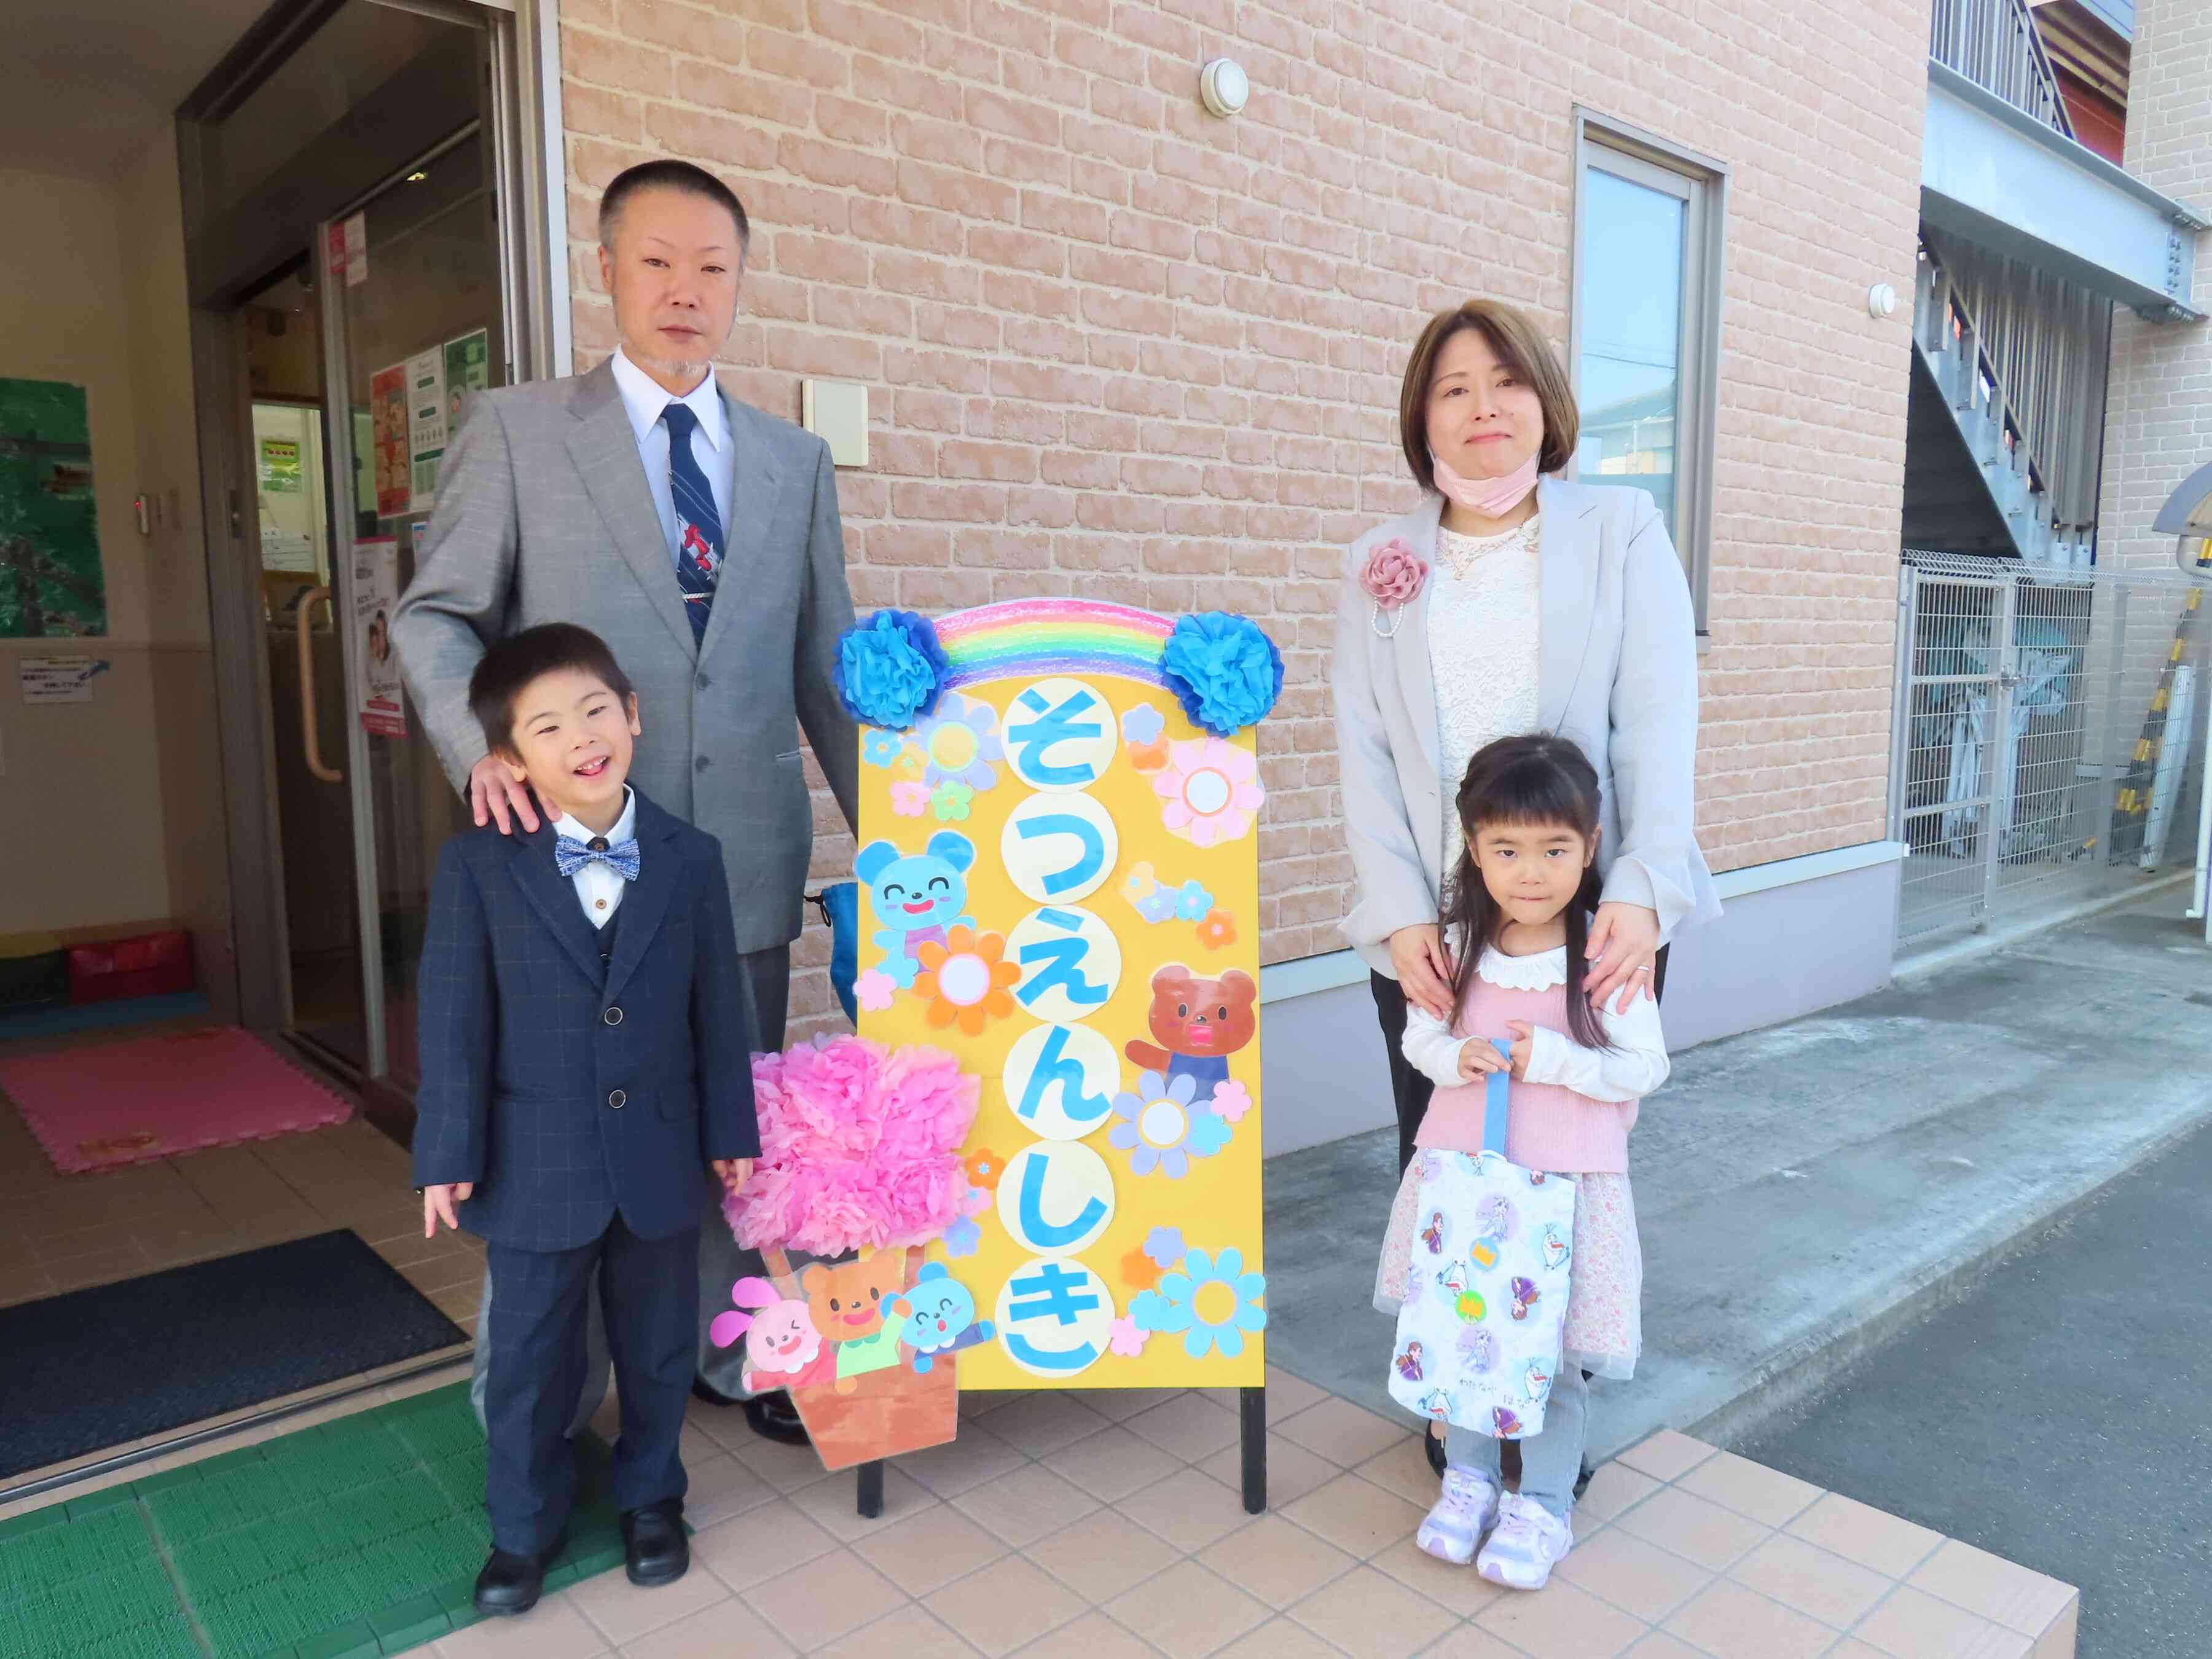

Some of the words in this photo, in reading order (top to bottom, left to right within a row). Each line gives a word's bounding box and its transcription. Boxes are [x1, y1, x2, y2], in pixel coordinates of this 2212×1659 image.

[1007, 689, 1110, 1370] そつえんしき
